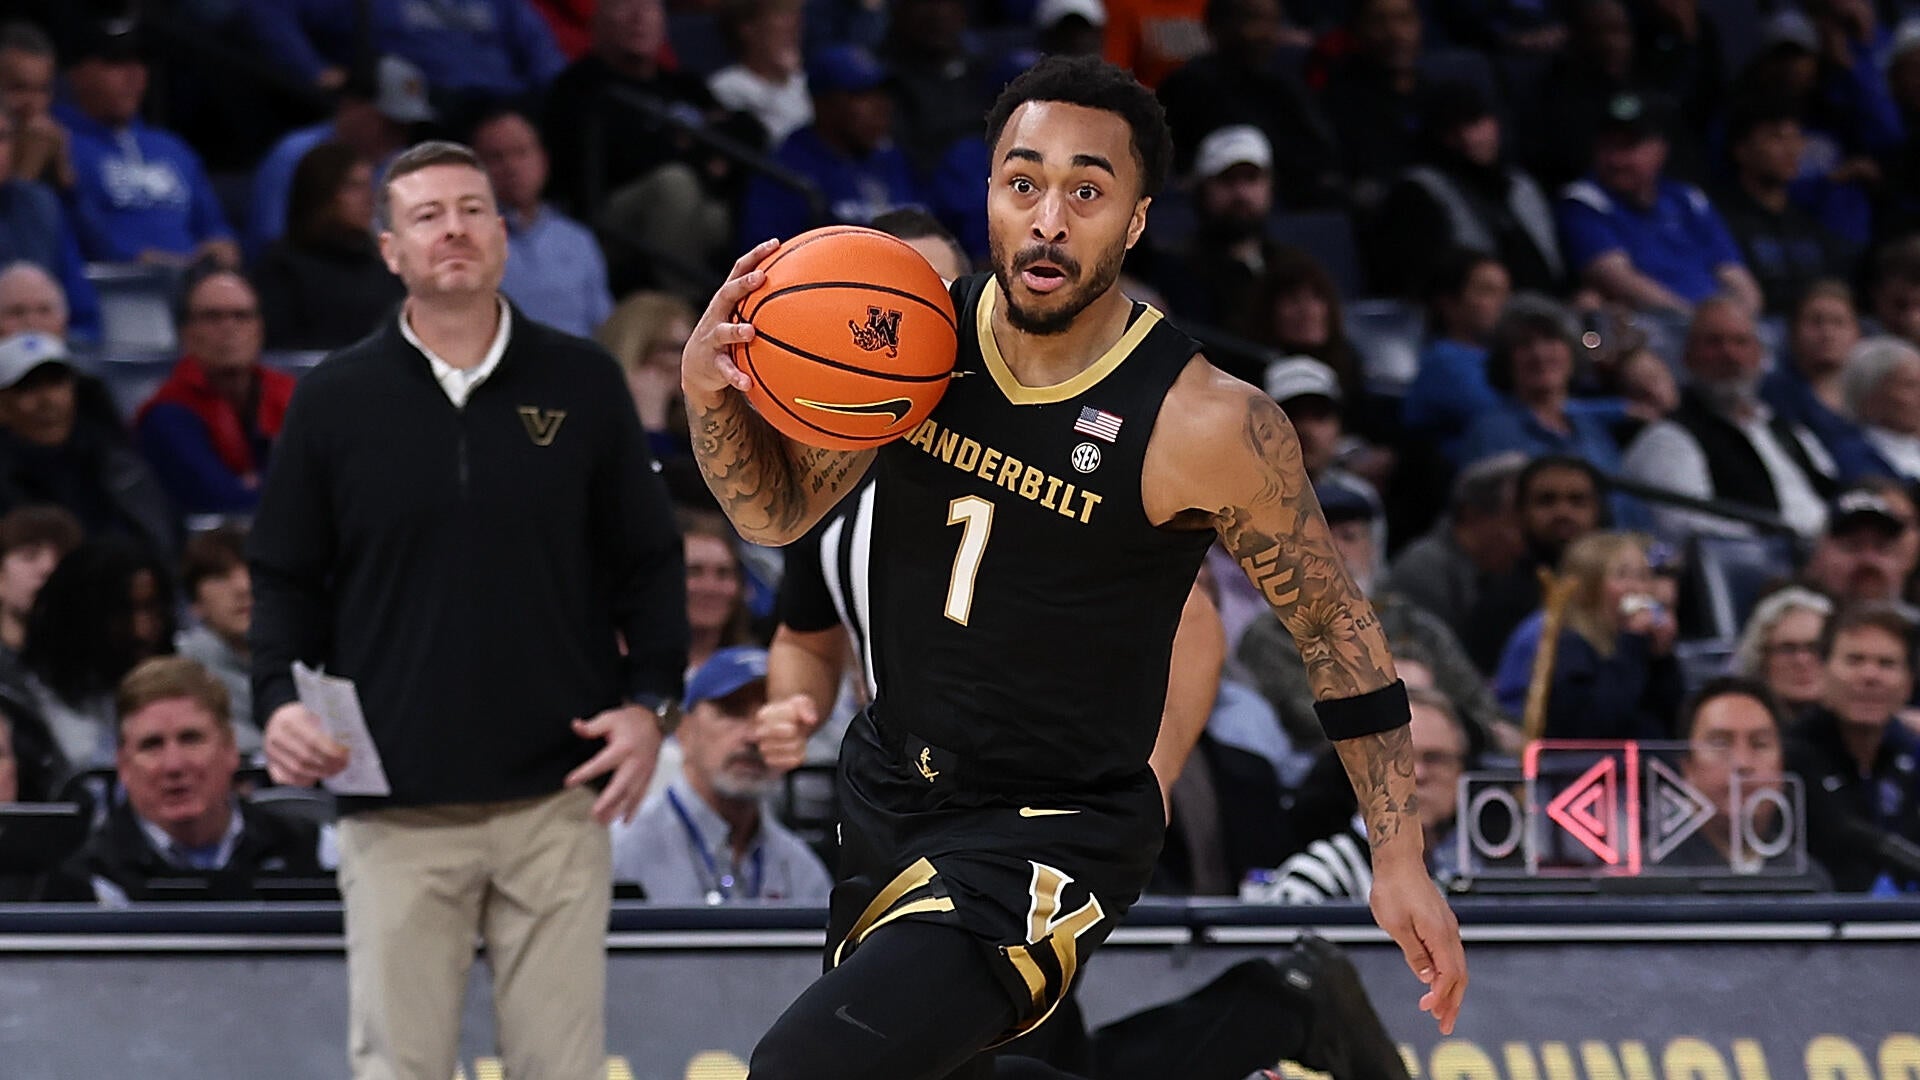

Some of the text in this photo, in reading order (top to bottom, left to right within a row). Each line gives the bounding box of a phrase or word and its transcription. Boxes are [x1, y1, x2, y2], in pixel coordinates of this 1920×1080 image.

[517, 406, 567, 446] V
[1073, 444, 1100, 472] SEC
[944, 494, 995, 627] 1
